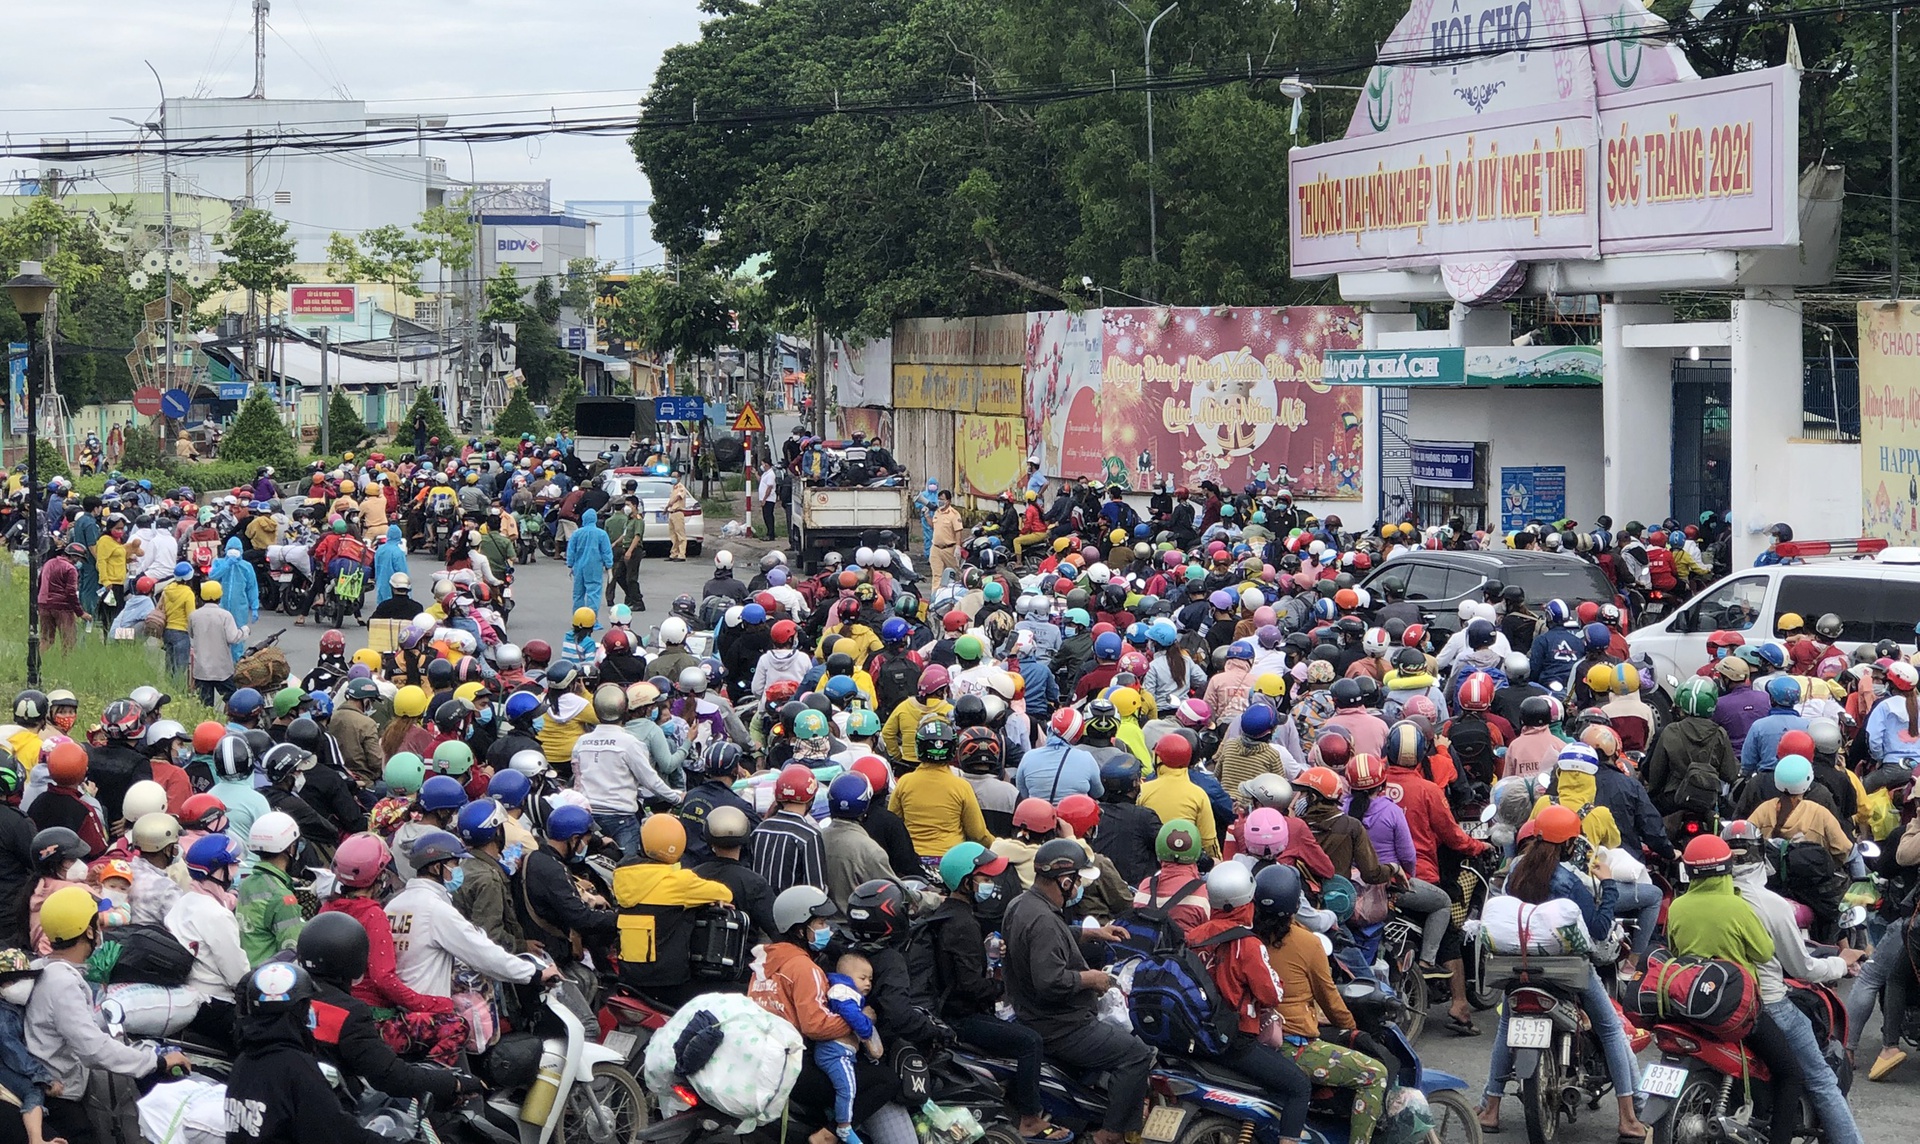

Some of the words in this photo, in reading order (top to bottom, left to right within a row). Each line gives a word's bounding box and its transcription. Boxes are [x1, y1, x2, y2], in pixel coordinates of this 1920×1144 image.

[1298, 172, 1342, 238] THƯƠNG
[1436, 149, 1453, 225] VÀ
[1455, 134, 1475, 224] GỖ
[1477, 141, 1498, 221] MỸ
[1501, 137, 1542, 236] NGHỆ
[1545, 125, 1586, 217] TỈNH
[1606, 121, 1642, 209] SÓC
[1644, 113, 1706, 204] TRĂNG
[1708, 121, 1754, 200] 2021
[497, 239, 527, 251] BIDV
[1103, 355, 1142, 392] Mừng
[1142, 354, 1181, 392] Đảng
[1182, 354, 1222, 389] Mừng
[1221, 346, 1263, 381] Xuân
[1340, 354, 1367, 382] QUÝ
[1368, 353, 1439, 378] KHÁCH
[1162, 396, 1192, 437] Chúc
[1194, 397, 1237, 434] Mừng
[1236, 397, 1275, 426] Năm
[1275, 397, 1308, 432] Mới
[1441, 454, 1470, 464] COVID-19
[1515, 1019, 1546, 1033] 54-Y5
[1513, 1033, 1544, 1046] 2577
[1650, 1066, 1681, 1082] 83-X1
